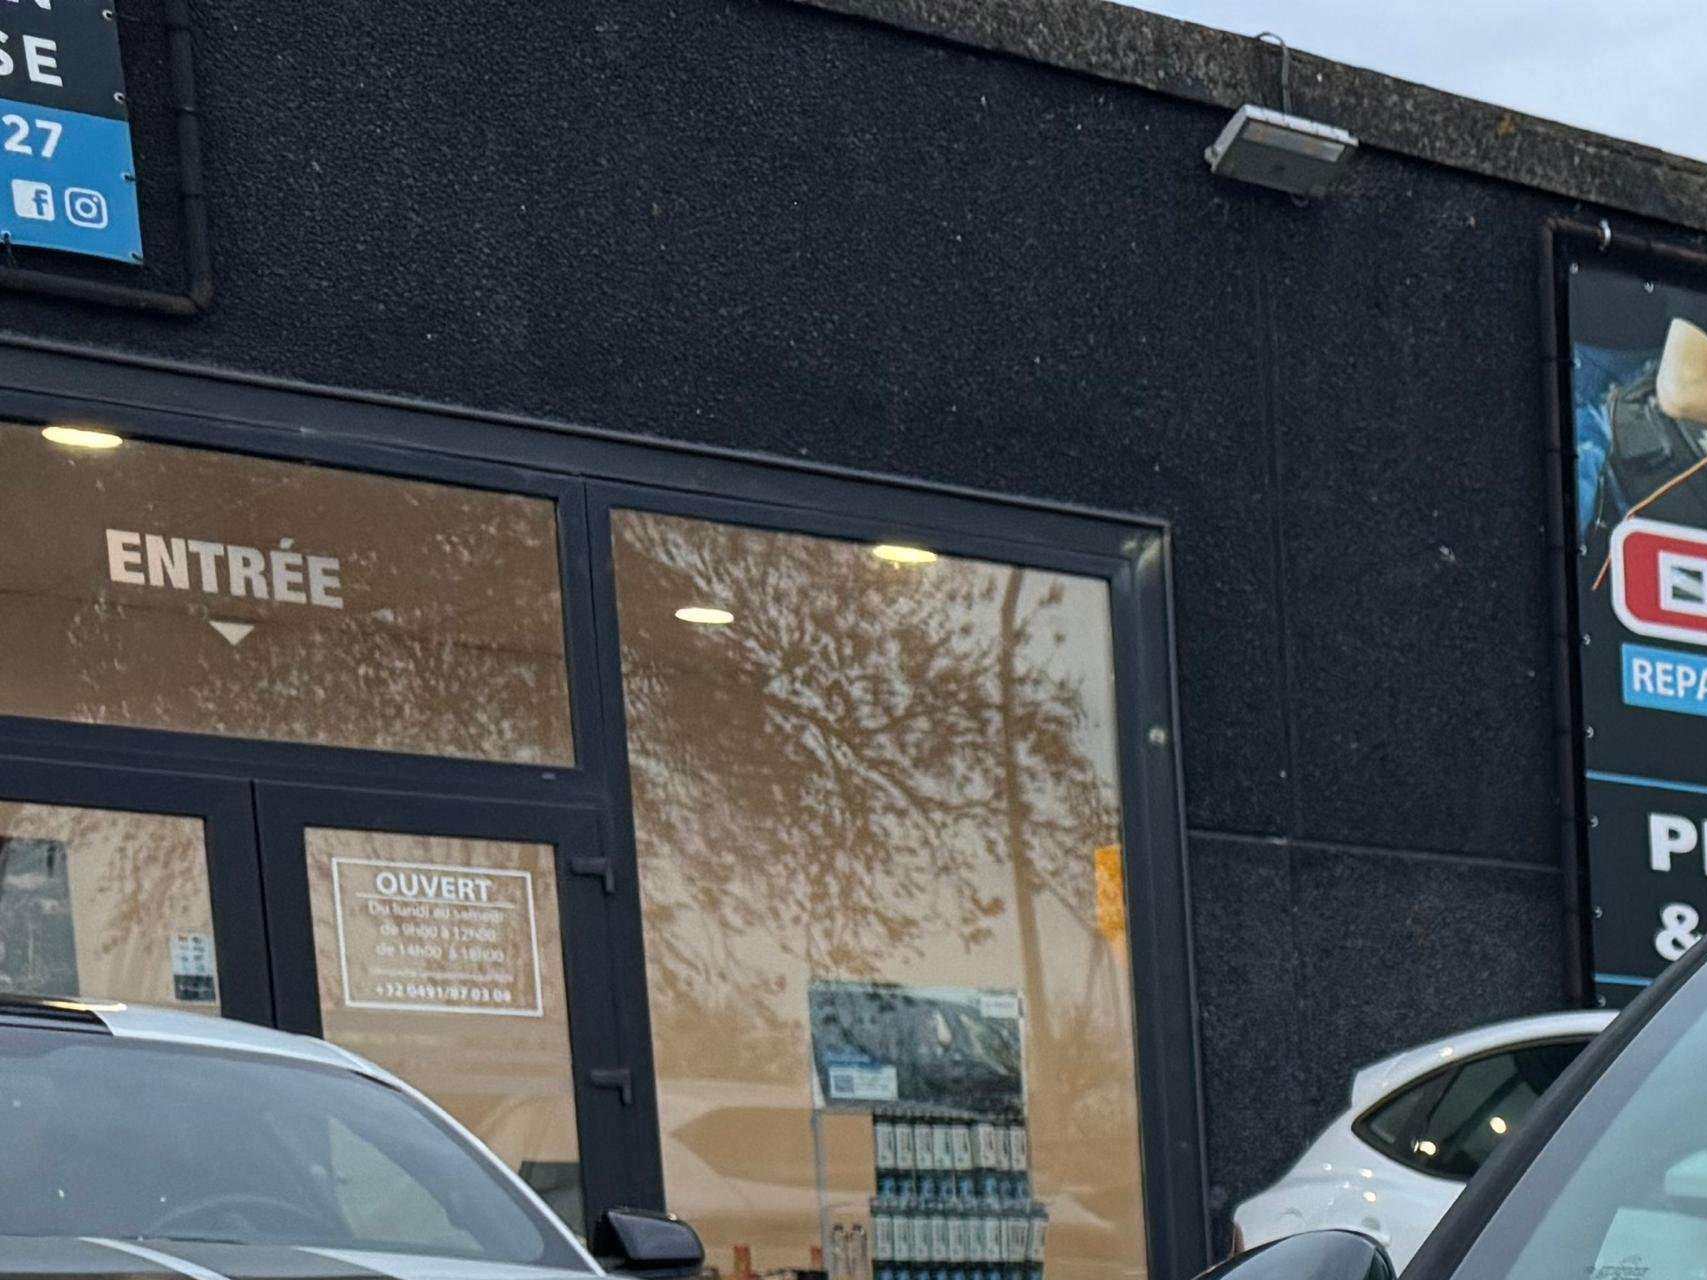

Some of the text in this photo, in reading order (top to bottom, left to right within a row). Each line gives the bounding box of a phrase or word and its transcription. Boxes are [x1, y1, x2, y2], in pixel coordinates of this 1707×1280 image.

[105, 528, 343, 609] ENTRÉE
[376, 871, 492, 902] OUVERT
[1655, 901, 1702, 962] &
